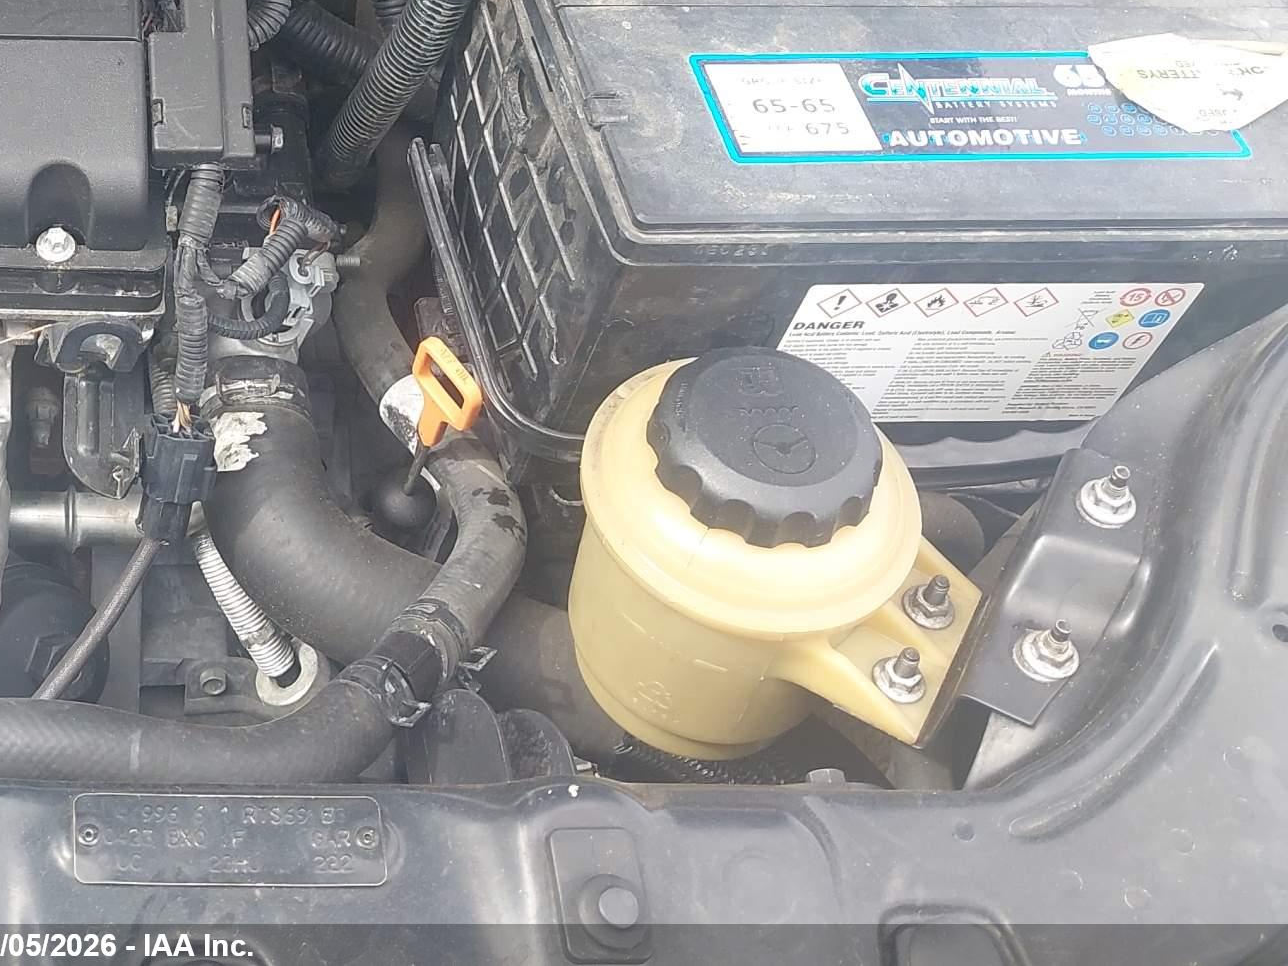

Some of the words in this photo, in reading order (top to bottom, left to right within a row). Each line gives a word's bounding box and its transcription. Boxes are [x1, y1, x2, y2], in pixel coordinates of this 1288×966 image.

[751, 98, 836, 114] 65-65
[934, 100, 992, 110] BATTERY
[998, 100, 1058, 109] SYSTEMS
[929, 115, 954, 124] START
[954, 115, 978, 124] WITH
[978, 115, 995, 124] THE
[804, 122, 850, 136] 675
[889, 128, 1082, 148] AUTOMOTIVE
[792, 320, 866, 331] DANGER
